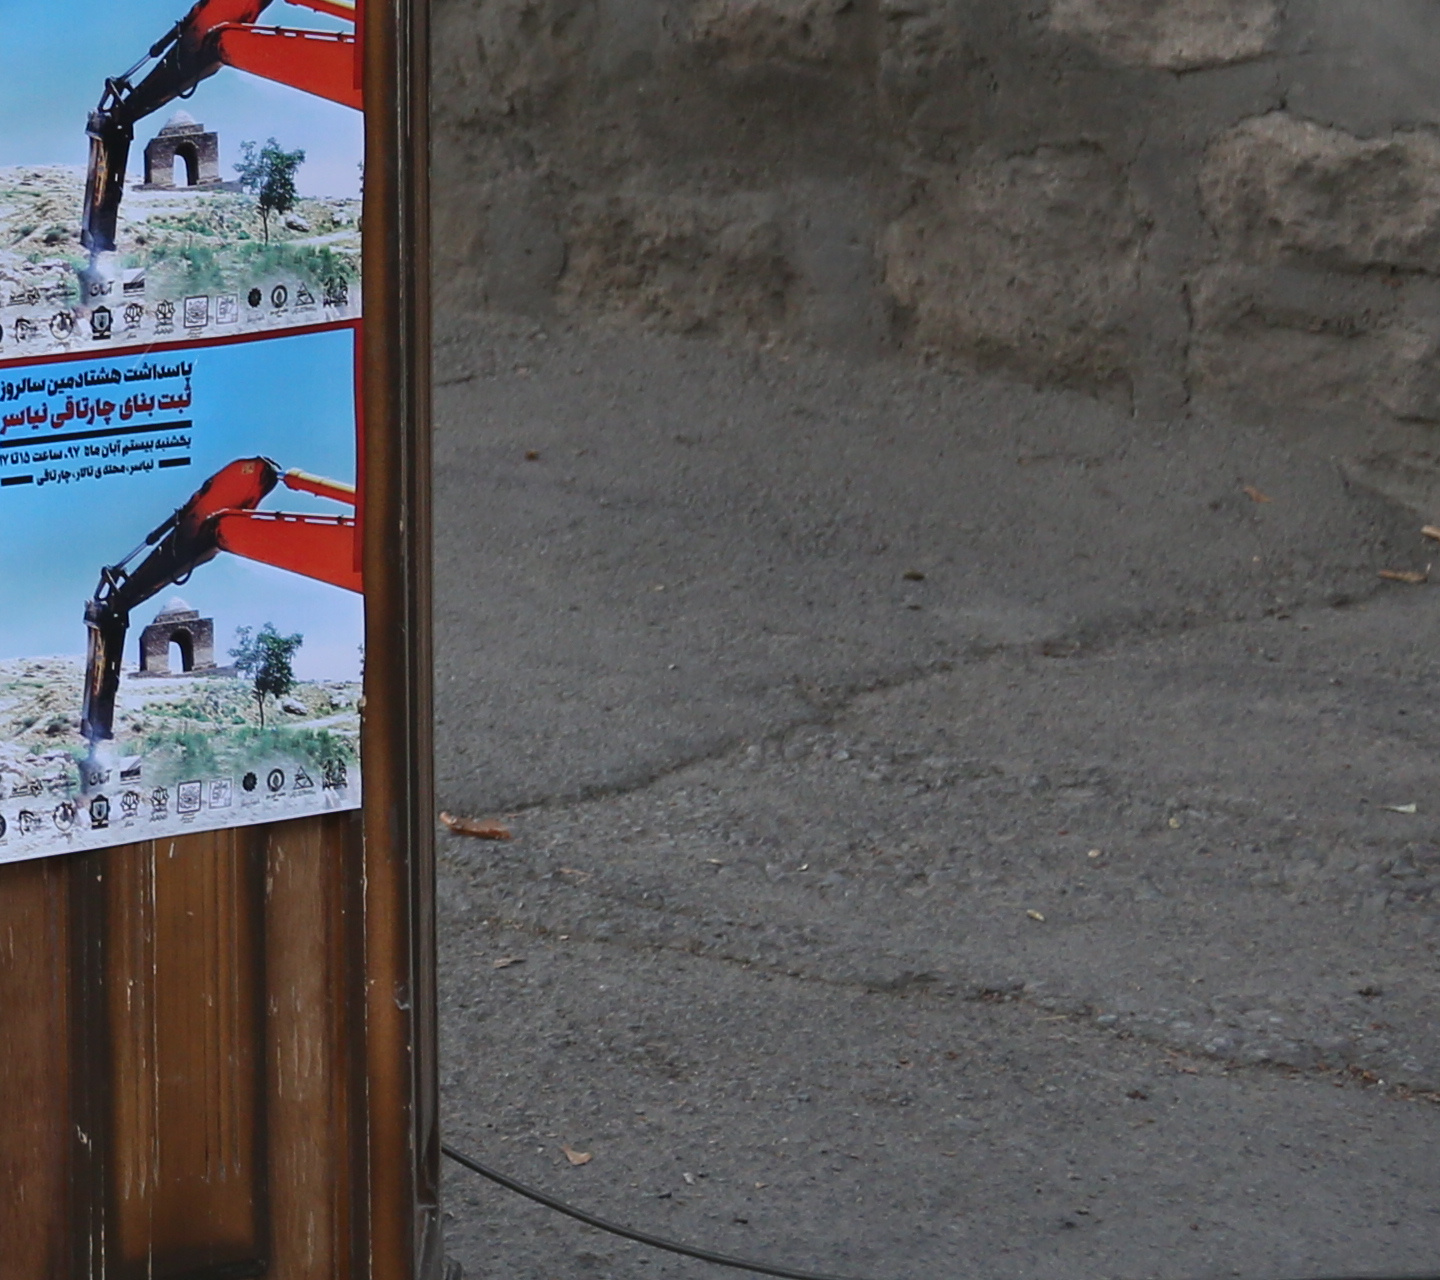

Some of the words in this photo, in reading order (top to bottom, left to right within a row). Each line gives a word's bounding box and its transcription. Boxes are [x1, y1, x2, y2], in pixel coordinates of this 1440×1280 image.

[47, 367, 122, 396] هشتادمین
[124, 361, 192, 383] پاسداشت
[0, 378, 45, 402] سالروز
[157, 383, 192, 414] ثبت
[51, 395, 116, 429] چارتاقی
[119, 393, 155, 420] بنای
[84, 445, 100, 457] ماه
[102, 440, 121, 459] آبان
[122, 438, 154, 455] بیستم
[155, 435, 191, 450] یکشنبه
[11, 452, 20, 465] تا
[32, 447, 63, 462] ساعت
